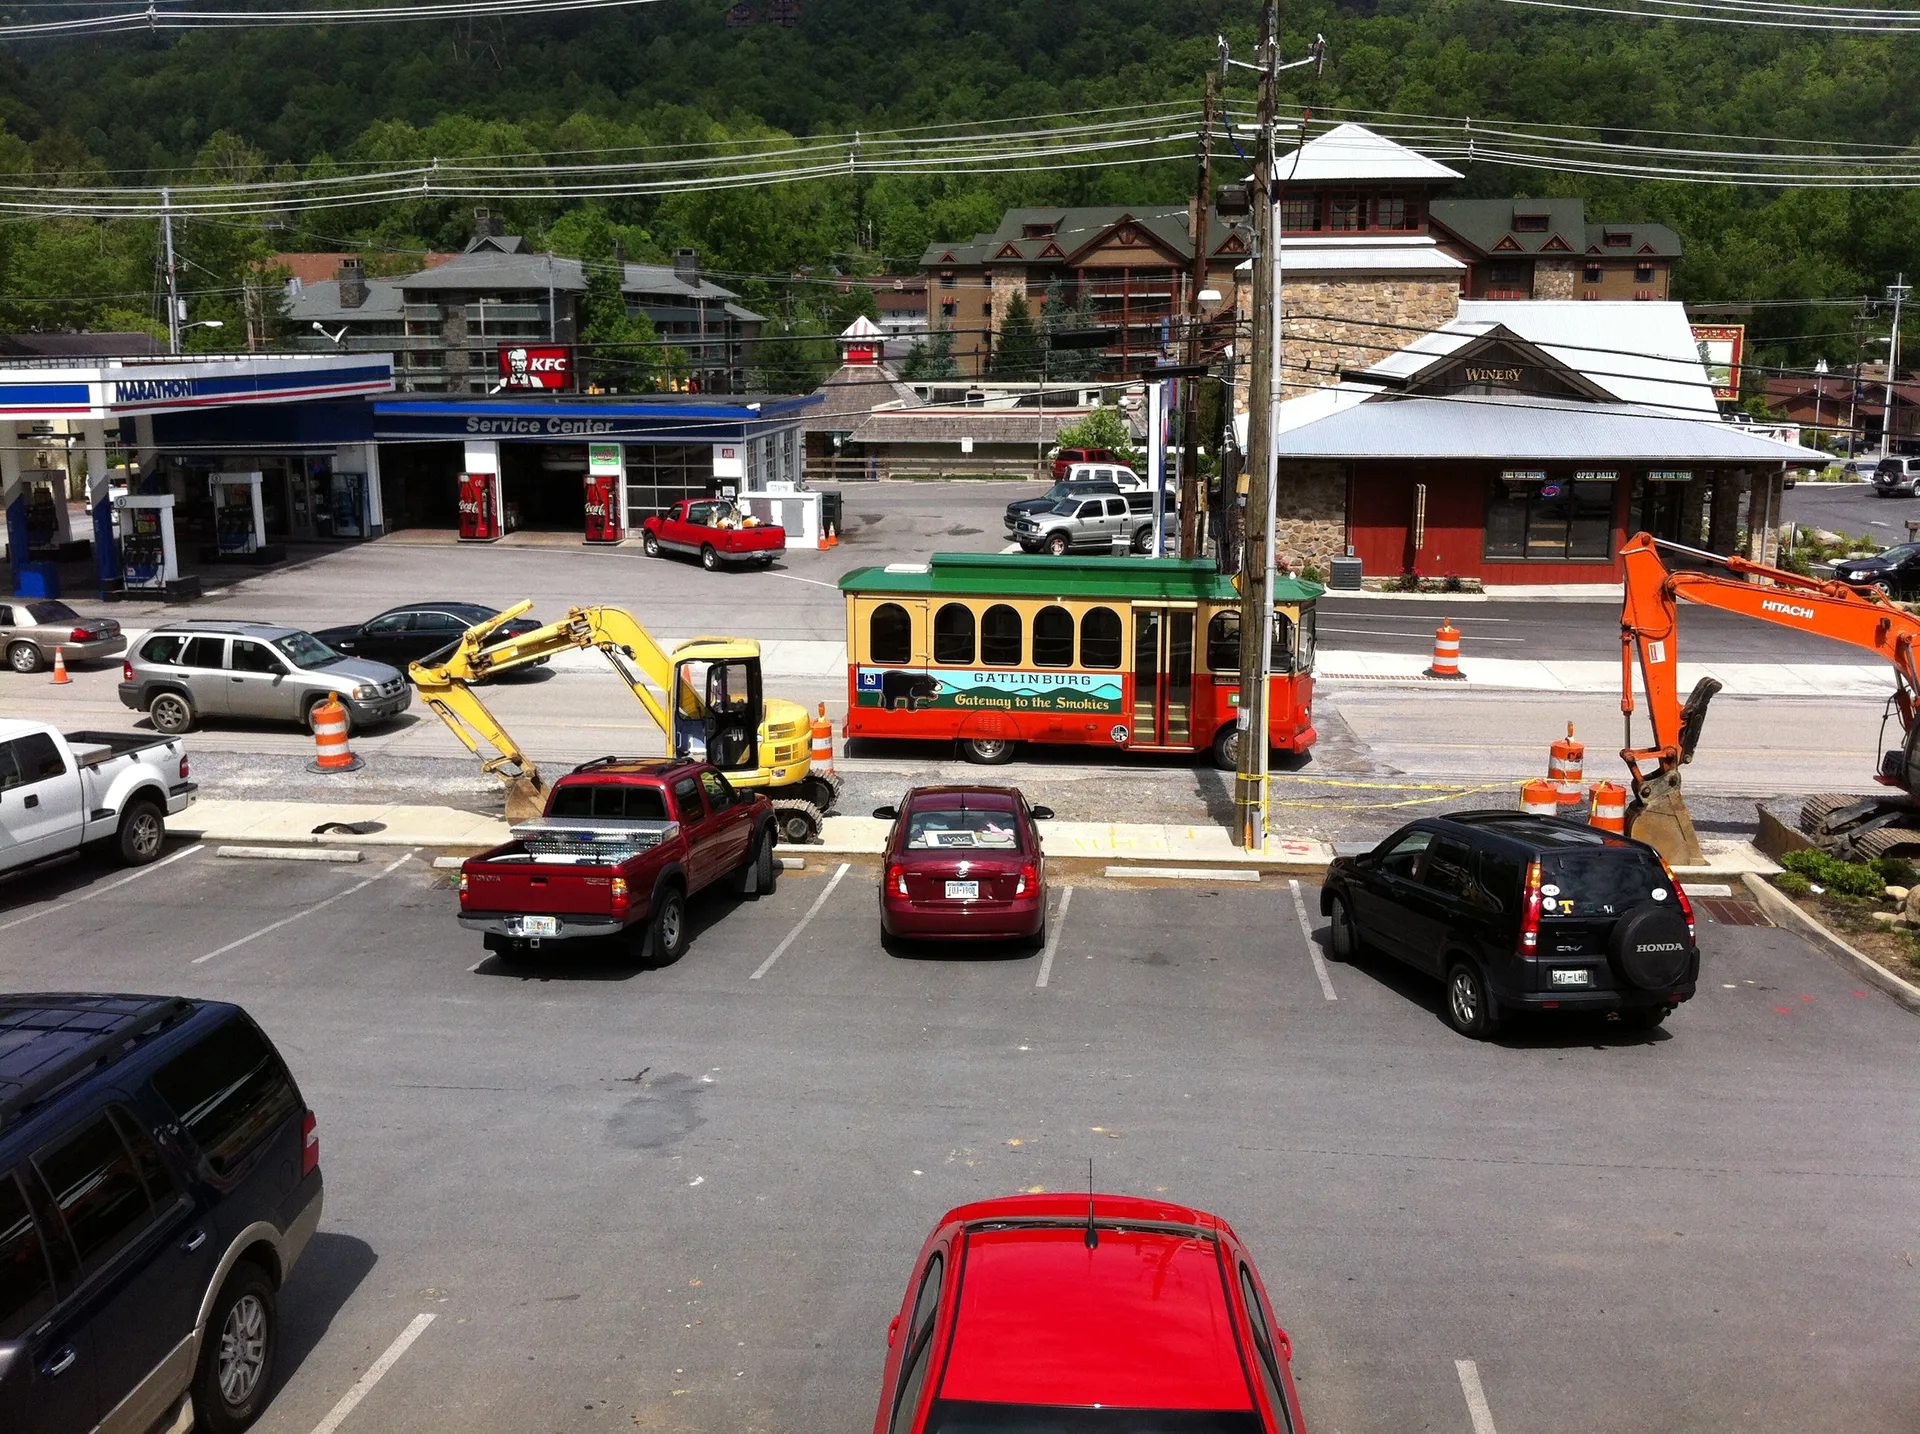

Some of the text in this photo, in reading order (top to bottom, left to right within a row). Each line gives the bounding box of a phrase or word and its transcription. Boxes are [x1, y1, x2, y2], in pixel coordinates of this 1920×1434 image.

[531, 358, 566, 371] KFC
[1465, 367, 1523, 381] WINERY
[116, 380, 191, 401] MARATHON
[466, 417, 614, 433] Service Center
[1576, 471, 1617, 479] OPEN DAILY
[1762, 600, 1814, 619] HITACHI
[974, 672, 1091, 685] GATLINBURG
[954, 694, 1109, 710] Gateway to the Smokies
[1636, 943, 1684, 953] HONDA
